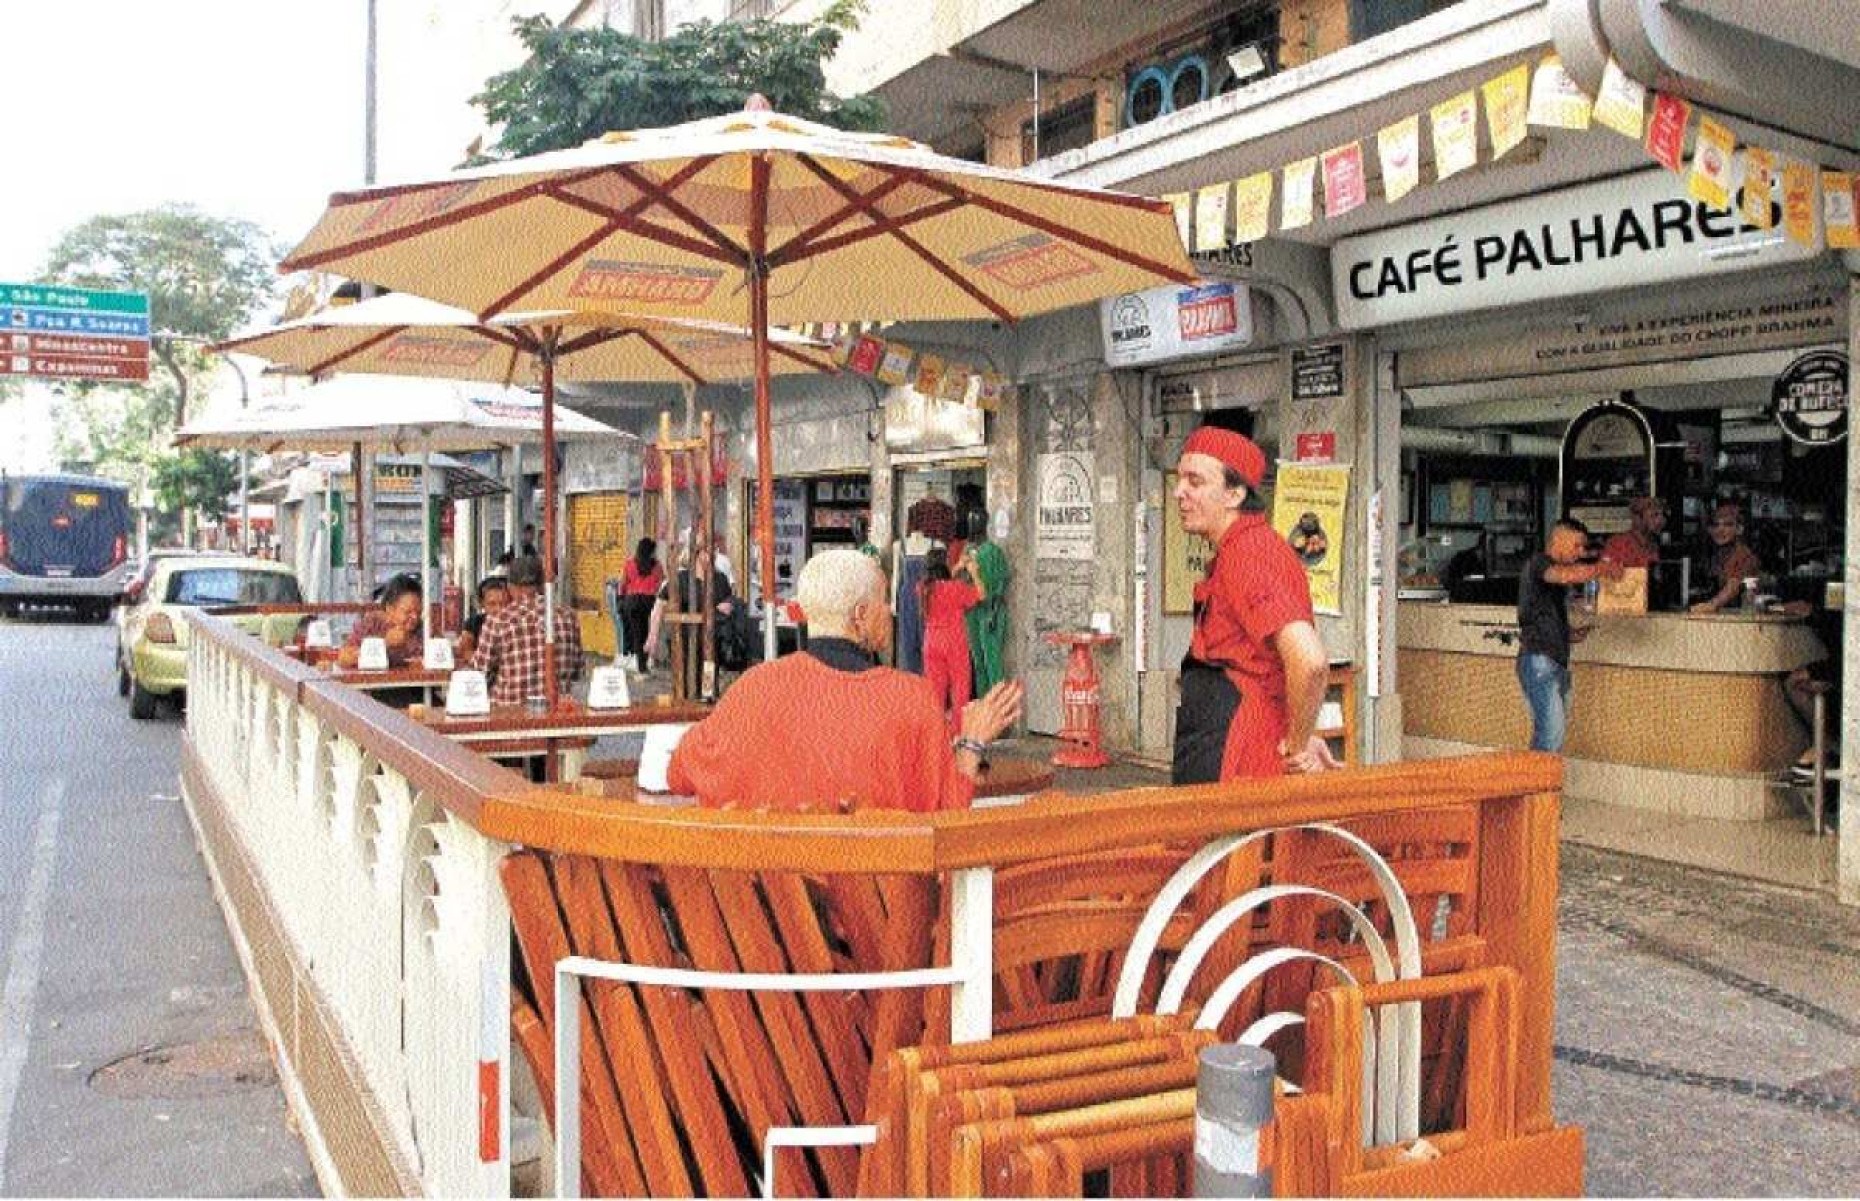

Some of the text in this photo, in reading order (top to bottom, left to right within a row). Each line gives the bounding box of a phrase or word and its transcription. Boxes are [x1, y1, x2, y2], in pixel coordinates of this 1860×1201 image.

[1349, 234, 1463, 300] CAFÉ
[1758, 296, 1834, 315] MINEIRA
[1670, 331, 1692, 345] DO
[1695, 324, 1751, 342] CHOPP
[1756, 316, 1835, 335] BRAHMA
